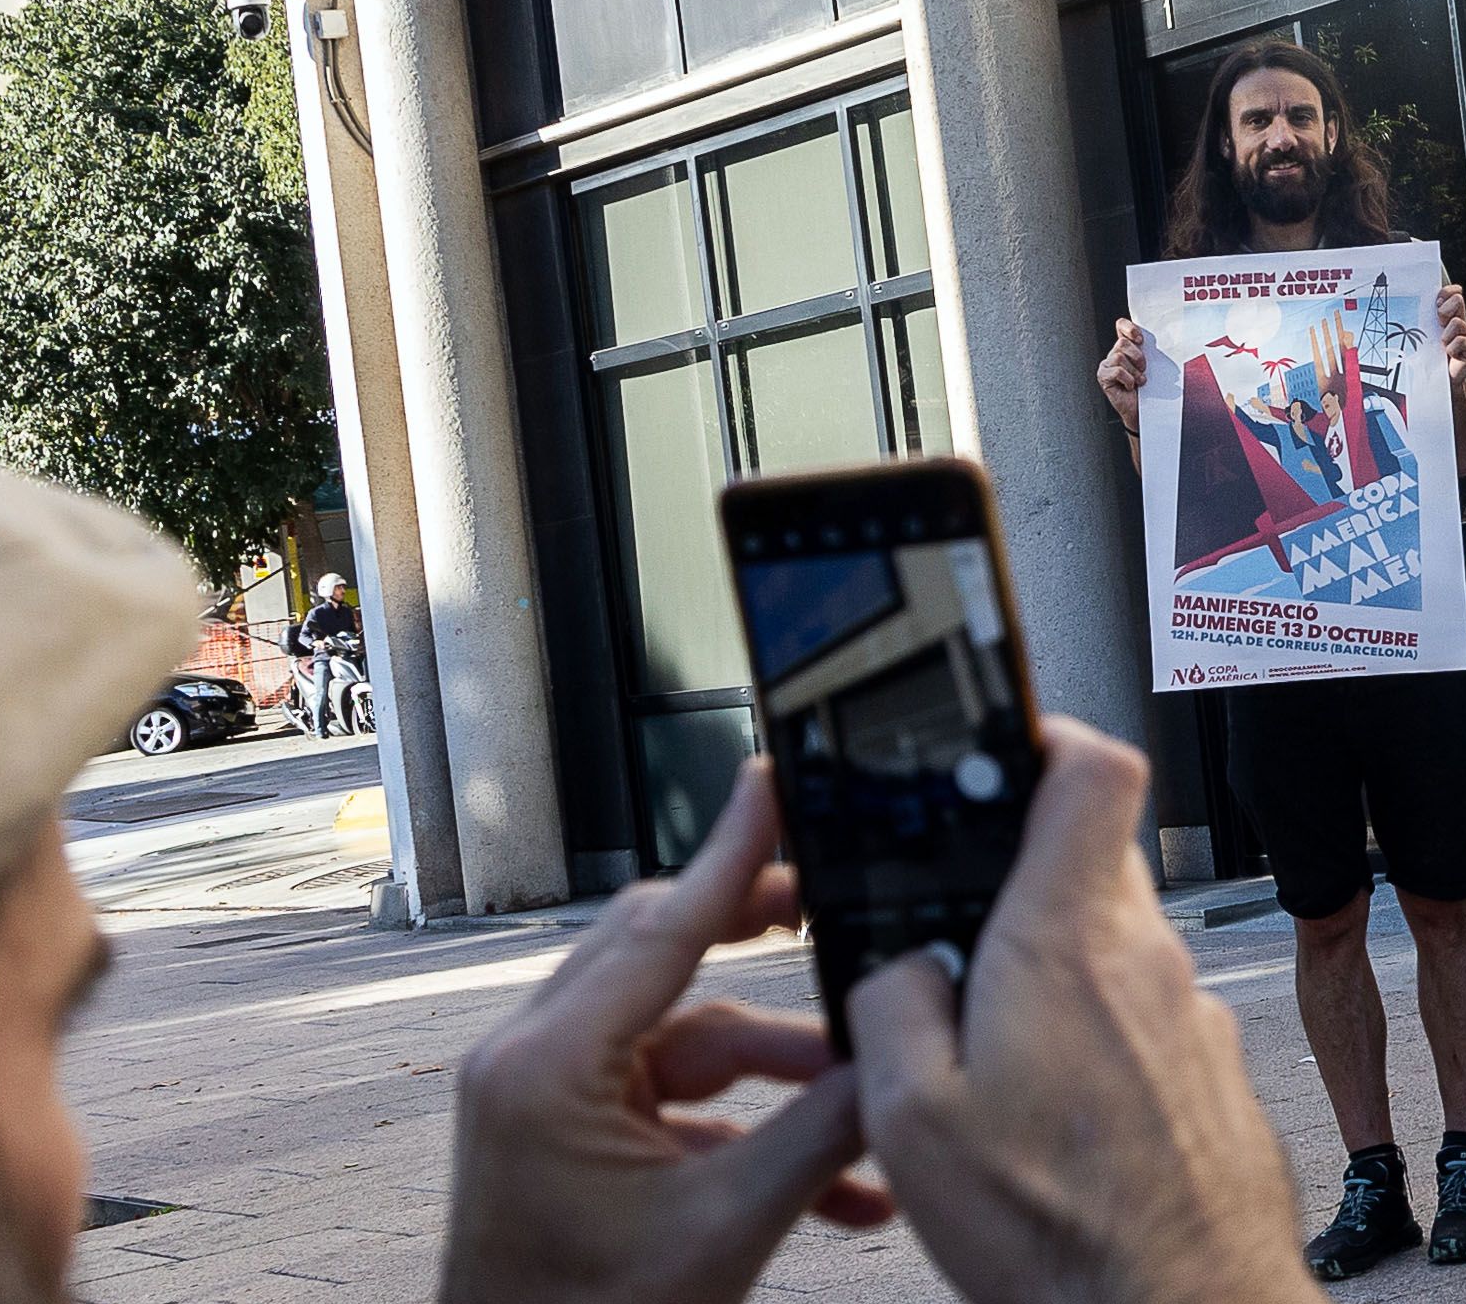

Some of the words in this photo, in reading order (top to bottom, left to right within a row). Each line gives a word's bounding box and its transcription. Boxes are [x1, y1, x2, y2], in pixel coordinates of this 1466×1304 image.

[1183, 272, 1276, 288] ENFONSEM
[1283, 269, 1353, 282] AQUEST
[1184, 287, 1241, 302] MODEL
[1248, 286, 1270, 297] DE
[1277, 282, 1338, 296] CIUTAT
[1349, 471, 1418, 510] COPA
[1302, 530, 1390, 595] MAI
[1173, 594, 1319, 621] MANIFESTACIÓ
[1171, 613, 1276, 635] DIUMENGE
[1281, 622, 1303, 638] 13
[1308, 624, 1419, 647] D'OCTUBRE
[1171, 630, 1198, 642] 12H.
[1200, 632, 1243, 646] PLAÇA
[1245, 637, 1263, 647] DE
[1266, 638, 1328, 652] CORREUS
[1330, 643, 1419, 660] (BARCELONA)
[1208, 665, 1238, 674] COPA
